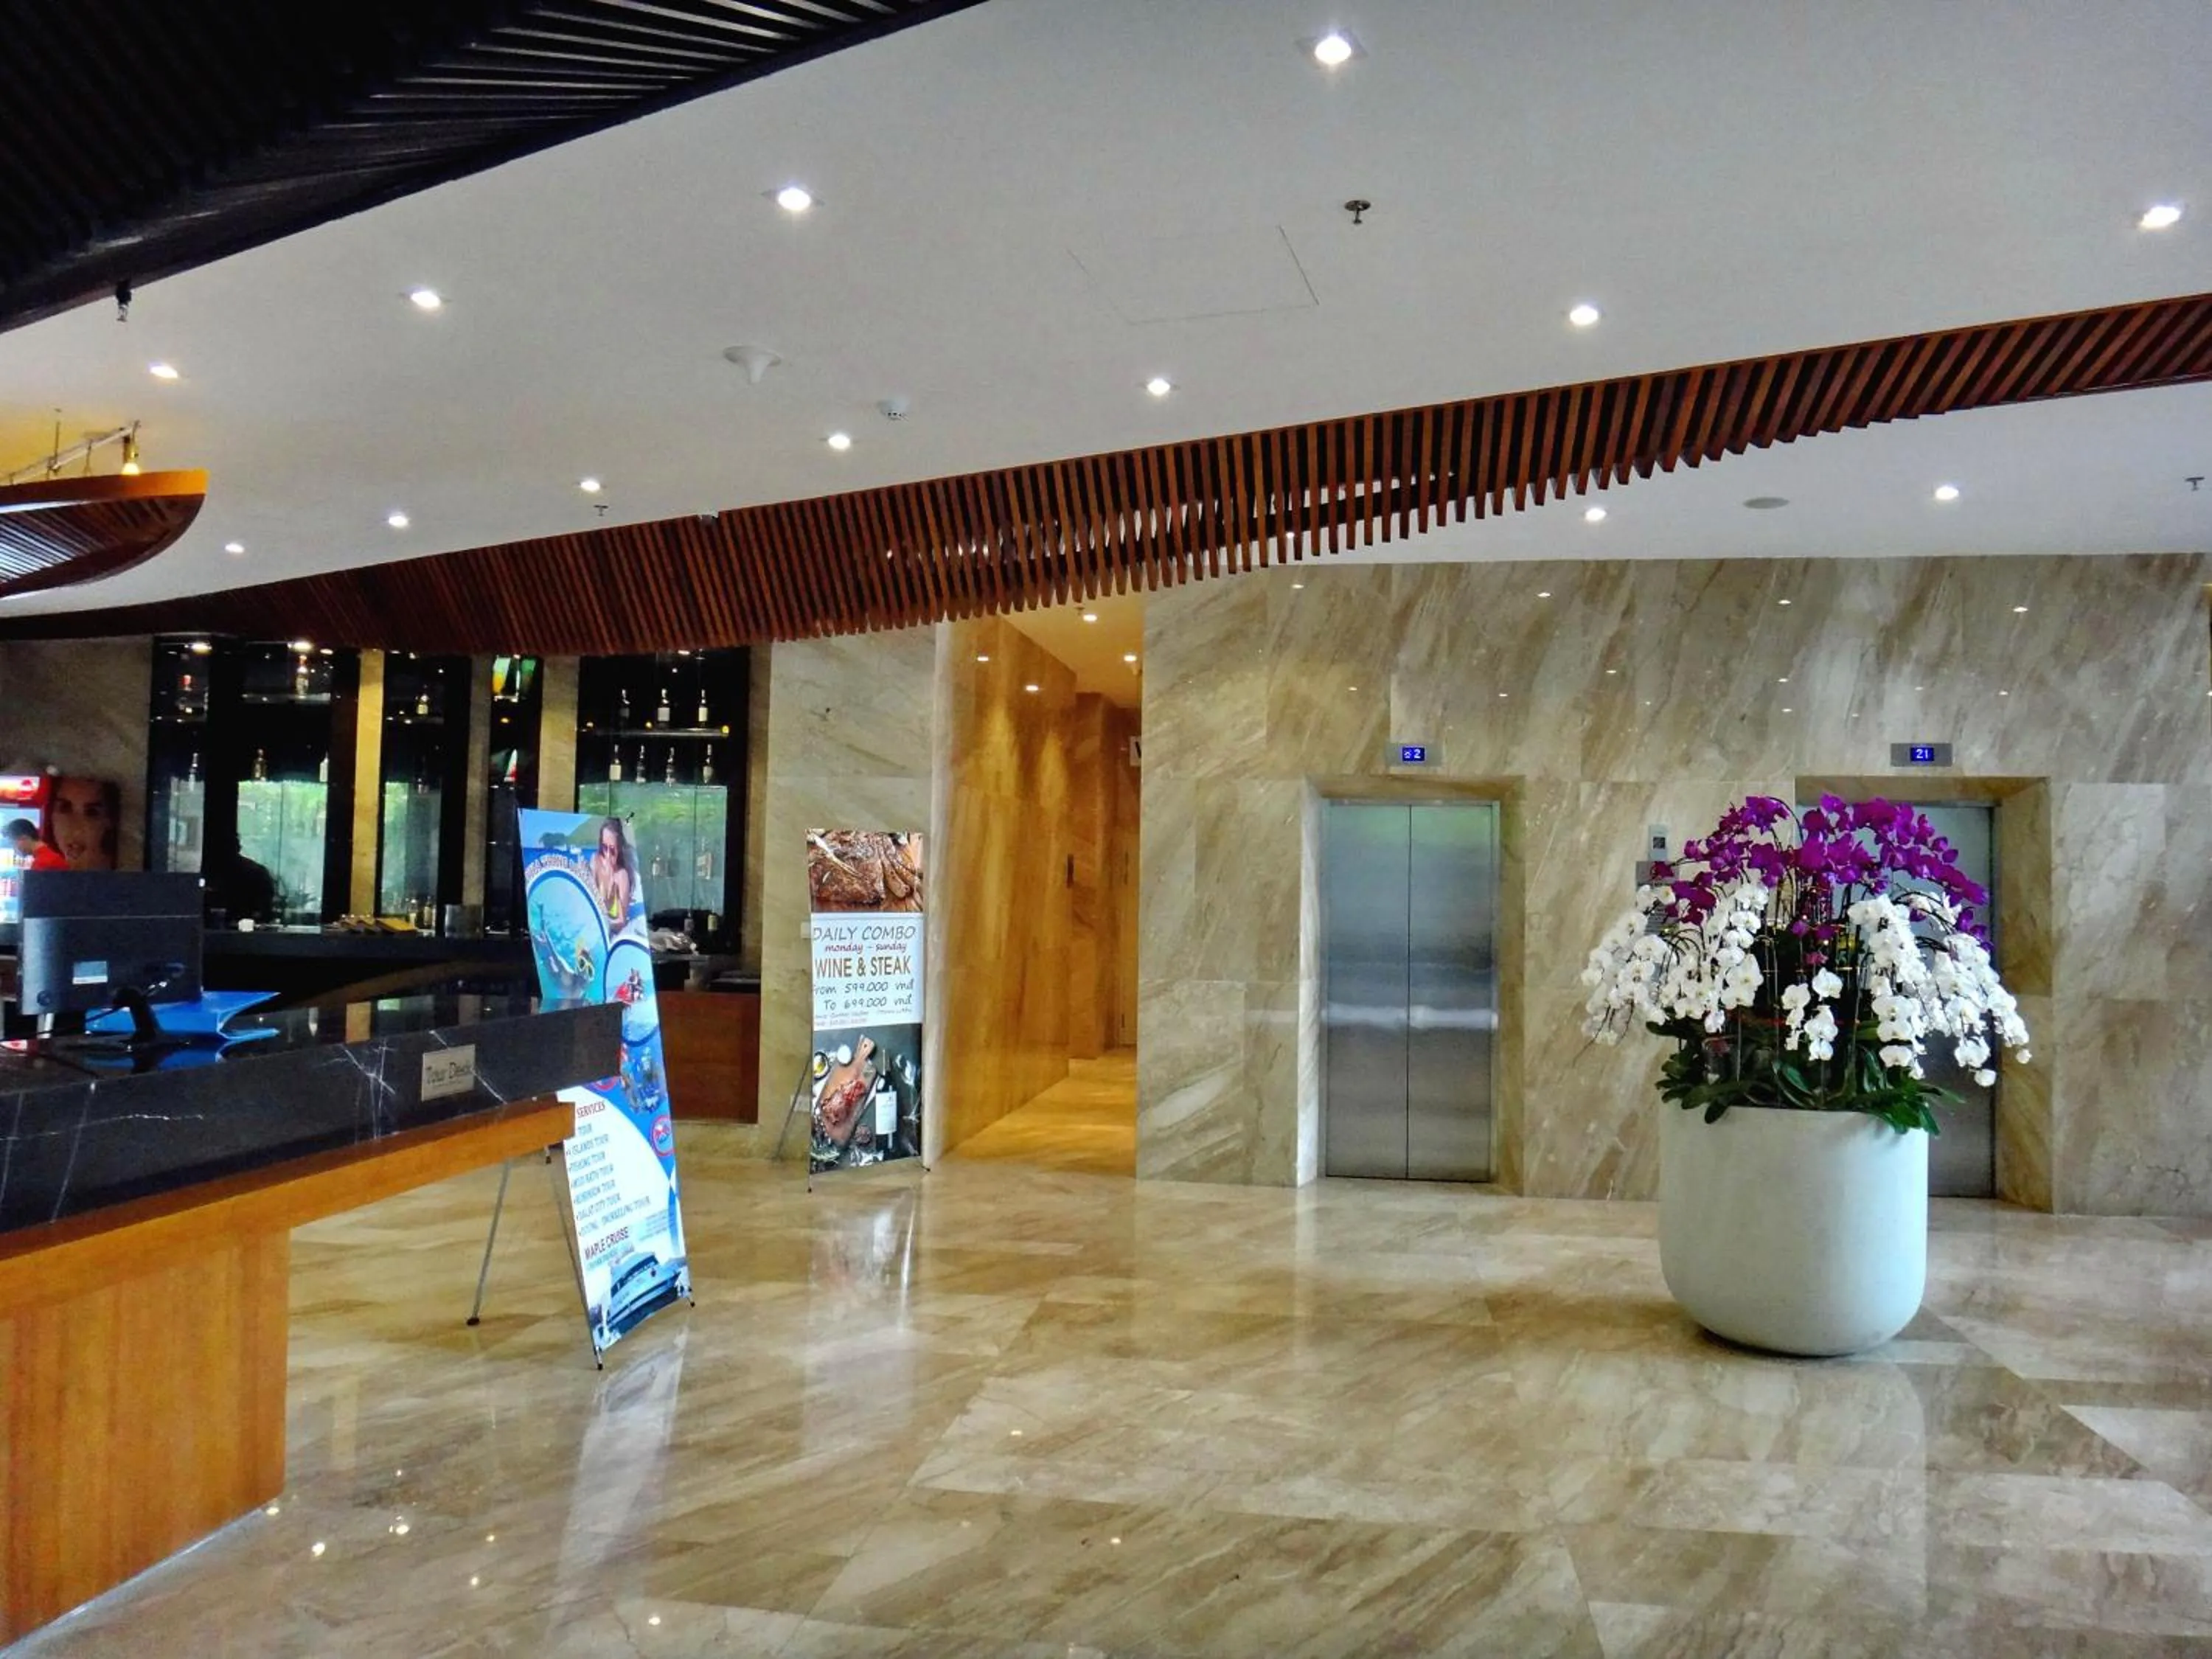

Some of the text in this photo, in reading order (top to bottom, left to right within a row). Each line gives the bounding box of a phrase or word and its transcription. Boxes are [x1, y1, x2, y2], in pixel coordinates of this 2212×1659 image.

[1916, 748, 1929, 759] 21
[813, 925, 917, 941] DAILY COMBO
[825, 942, 863, 953] monday
[875, 942, 907, 953] sunday
[815, 955, 911, 979] WINE & STEAK
[824, 1000, 836, 1011] To
[844, 997, 887, 1009] 699.000
[577, 1100, 605, 1118] SERVICES
